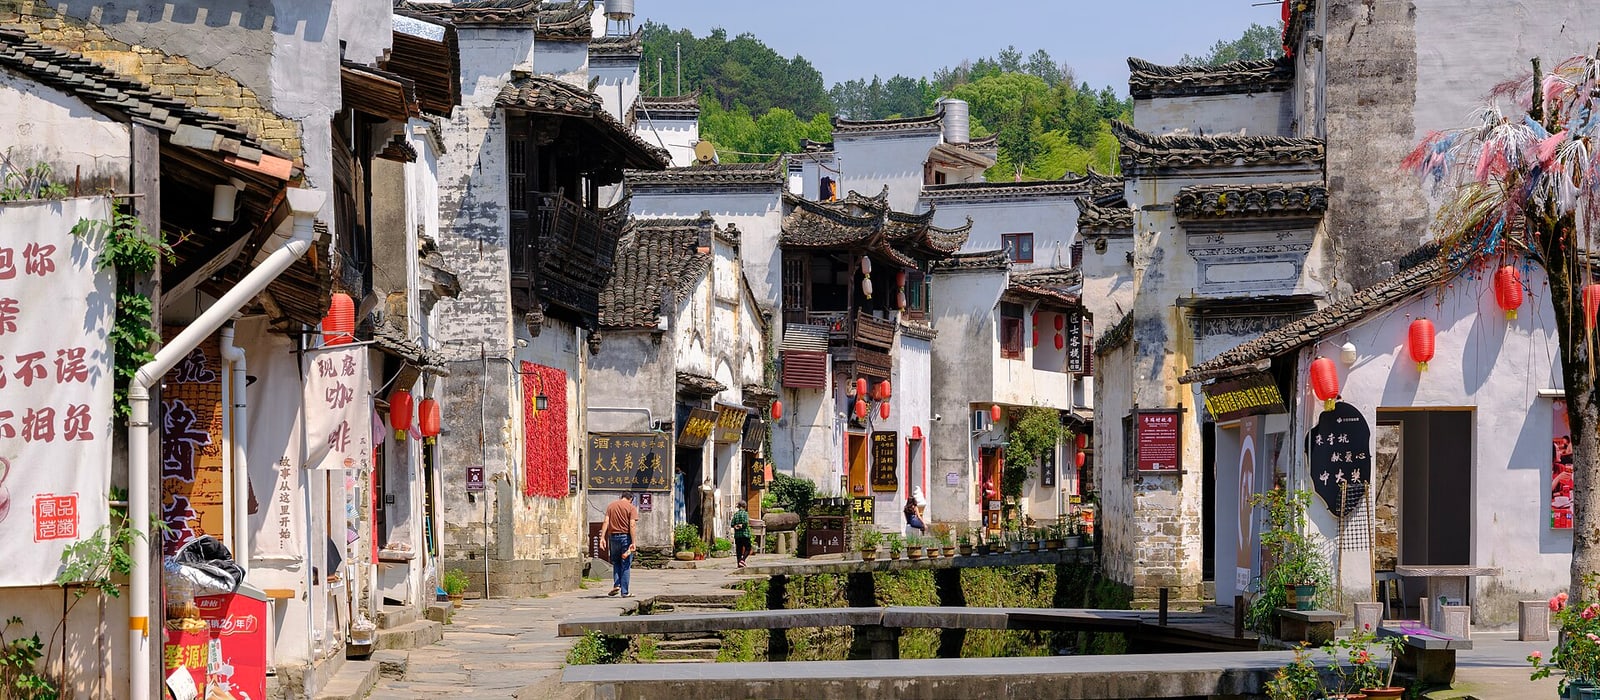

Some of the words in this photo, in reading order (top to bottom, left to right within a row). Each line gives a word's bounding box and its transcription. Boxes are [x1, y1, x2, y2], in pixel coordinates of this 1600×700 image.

[0, 346, 89, 389] 不误
[318, 355, 356, 378] 现磨
[326, 380, 353, 453] 咖啡
[1320, 468, 1361, 486] 中大奖
[853, 499, 872, 512] 早餐
